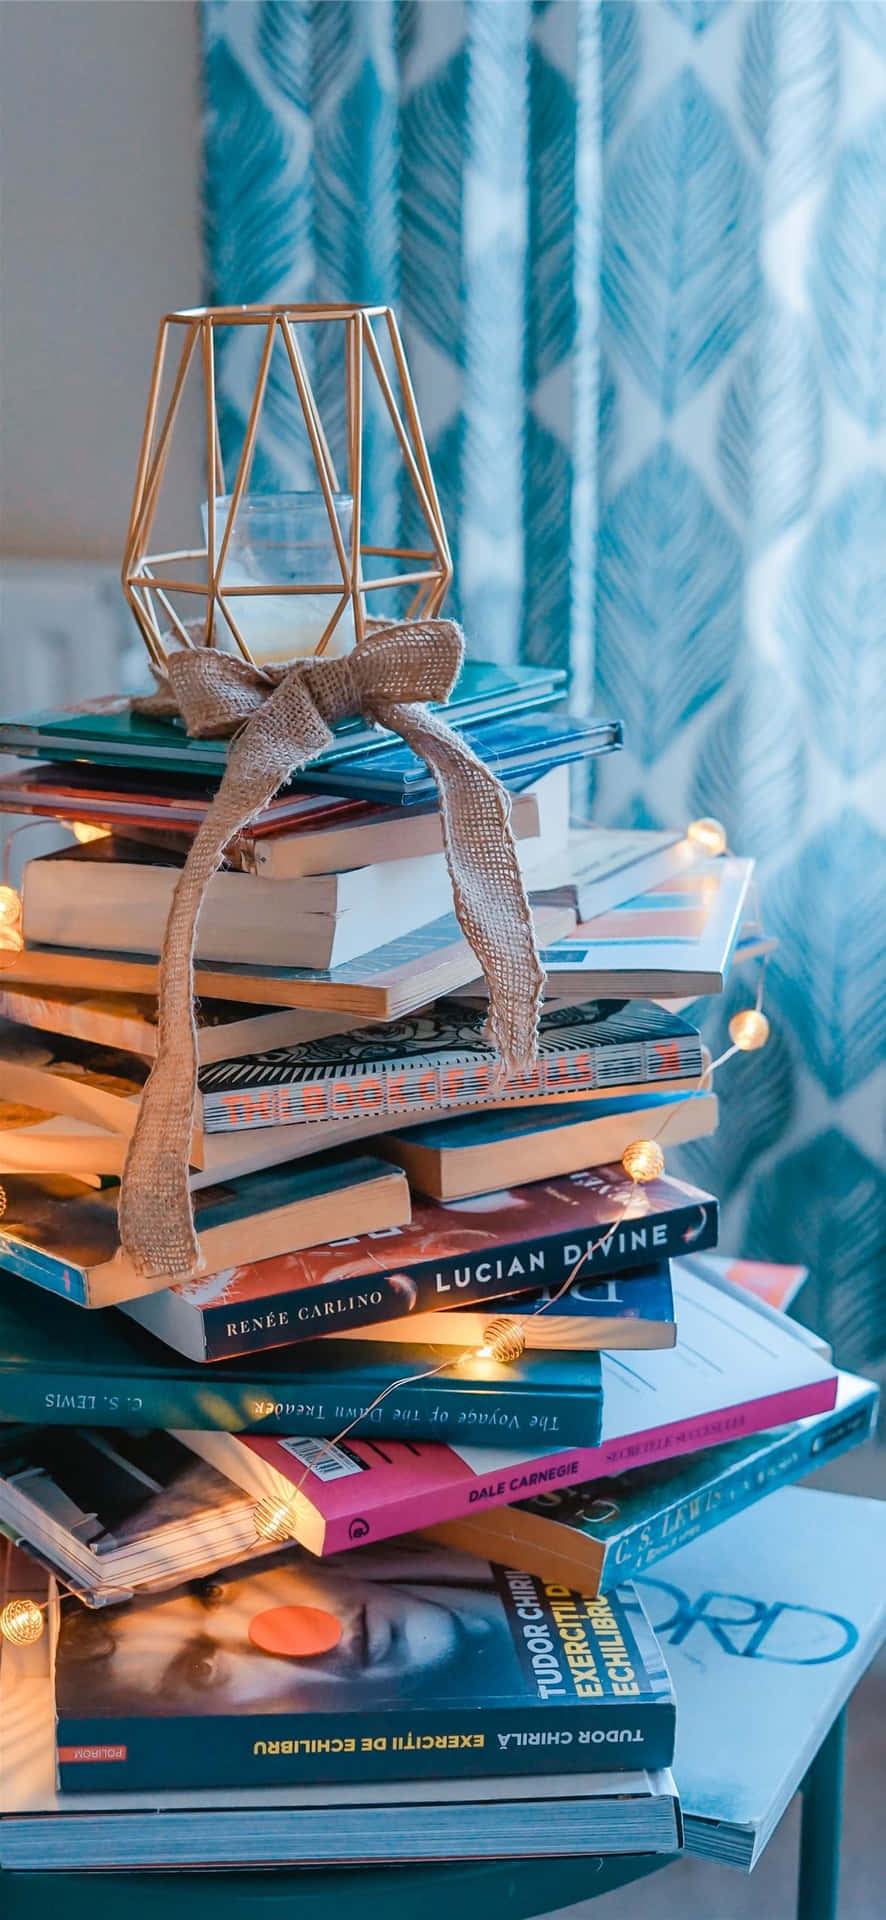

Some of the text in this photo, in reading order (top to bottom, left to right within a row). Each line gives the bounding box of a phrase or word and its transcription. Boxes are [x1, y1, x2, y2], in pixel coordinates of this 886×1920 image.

[302, 1074, 408, 1116] BOOK
[417, 1066, 464, 1105] OF
[226, 1310, 289, 1337] RENÉE
[297, 1290, 383, 1321] CARLINO
[435, 1250, 545, 1293] LUCIAN
[562, 1224, 668, 1266] DIVINE
[45, 1393, 97, 1410] LEWIS
[103, 1395, 119, 1410] S.
[334, 1406, 383, 1423] Dawn
[457, 1407, 521, 1430] Voyage
[528, 1414, 560, 1432] The
[468, 1481, 506, 1503] DALE
[509, 1461, 580, 1491] CARNEGIE
[522, 1624, 567, 1700] TUDOR
[361, 1737, 387, 1751] DE
[497, 1731, 571, 1749] CHIRILĂ
[578, 1729, 645, 1744] TUDOR
[74, 1747, 123, 1760] POLIROM
[253, 1738, 356, 1757] ECHILIBRU
